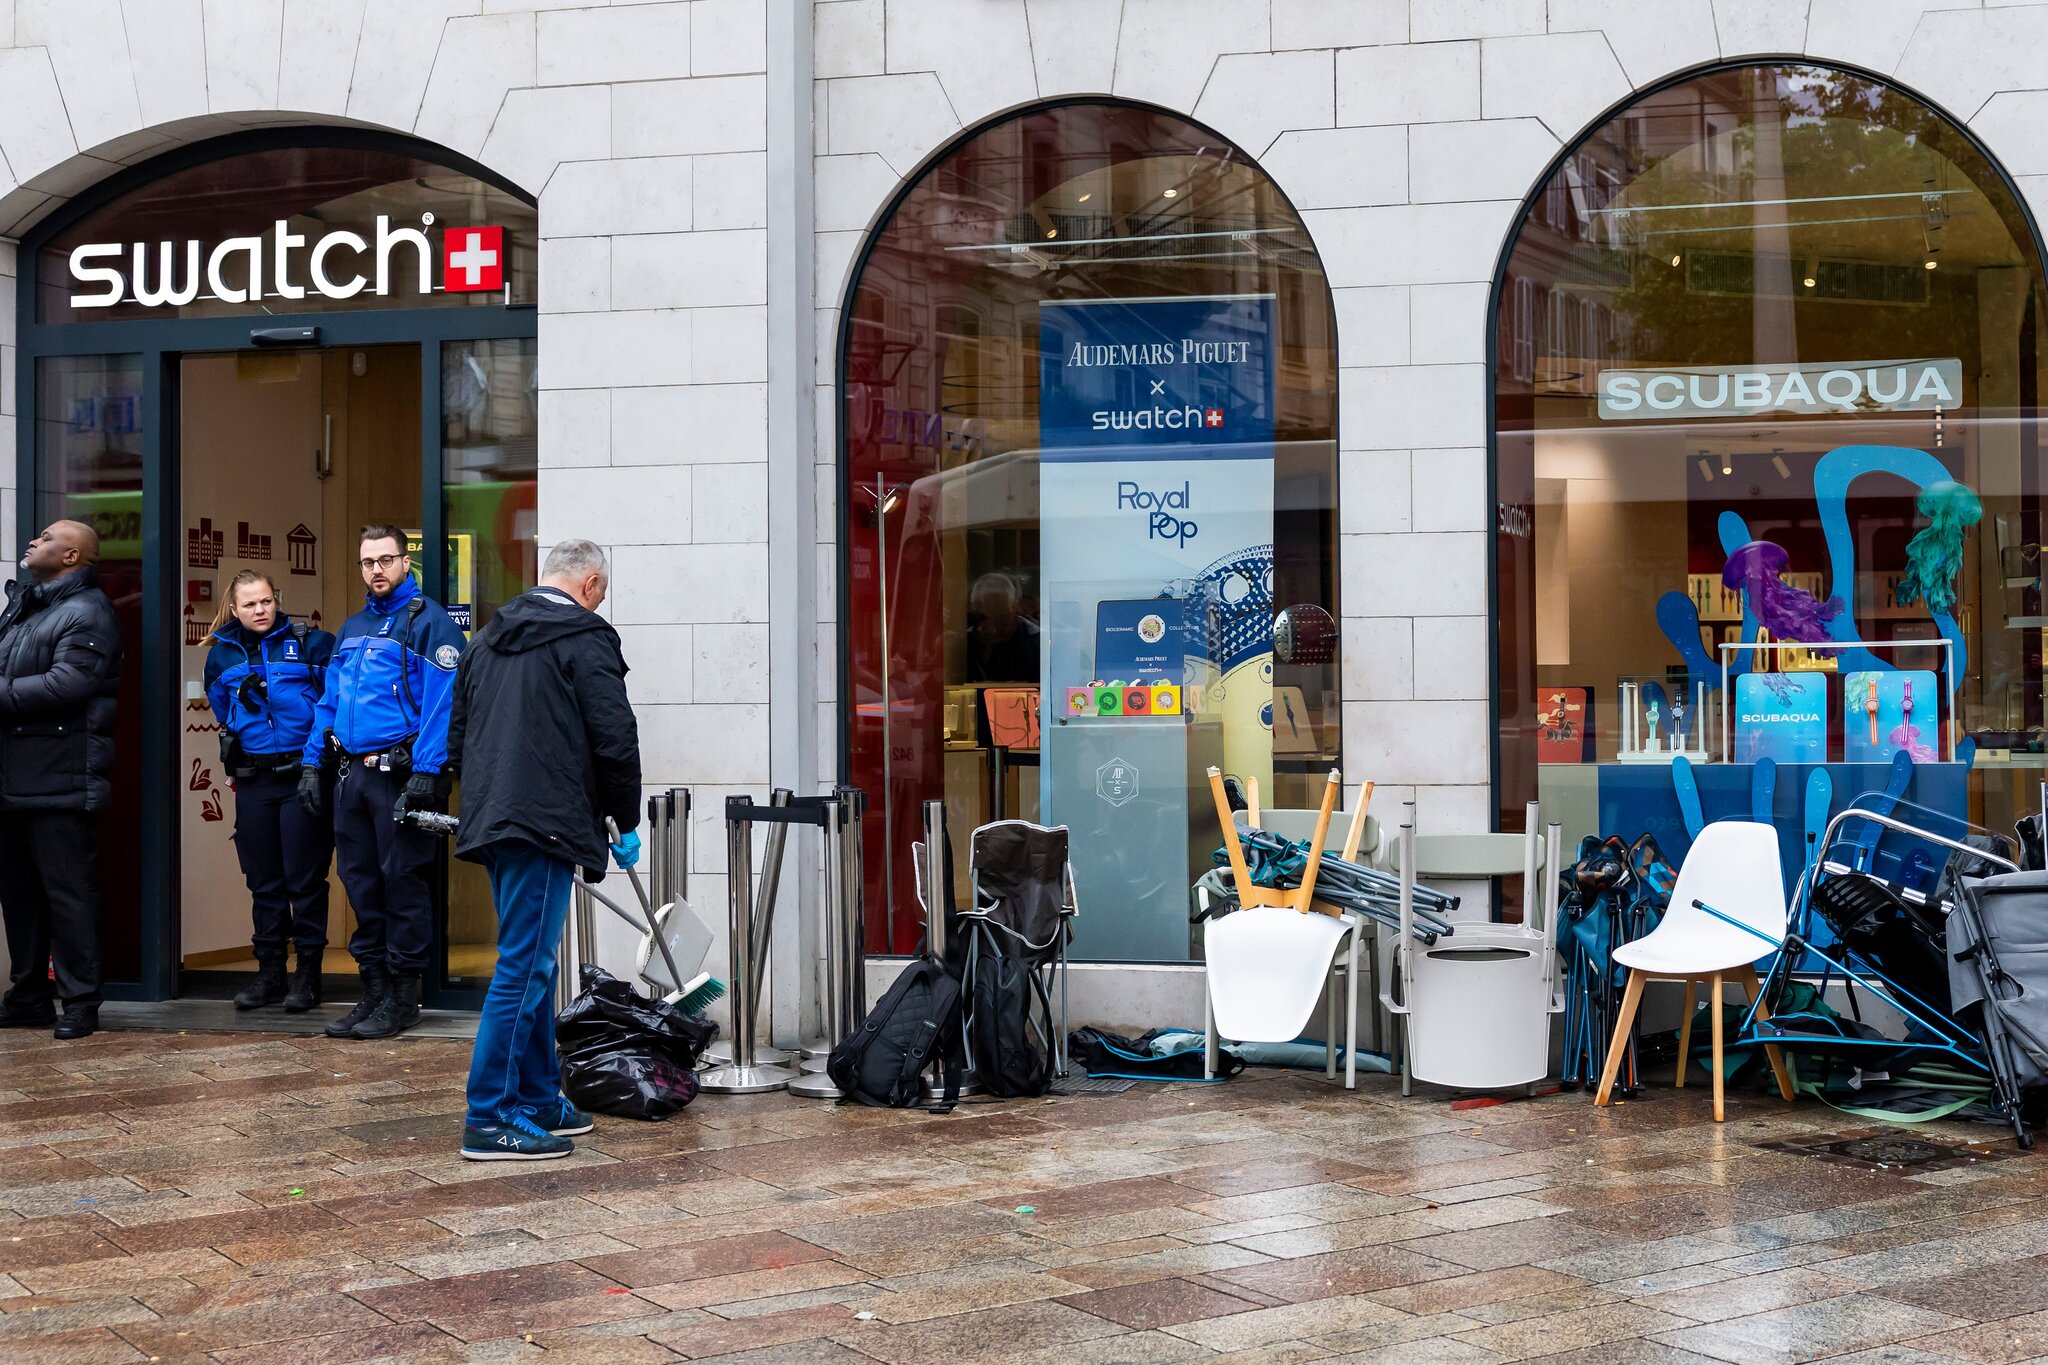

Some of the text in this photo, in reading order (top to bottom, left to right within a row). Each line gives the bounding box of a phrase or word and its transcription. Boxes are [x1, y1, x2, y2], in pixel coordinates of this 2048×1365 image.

[68, 214, 432, 308] swatch
[1067, 338, 1250, 367] AUDEMARS PIGUET
[1604, 367, 1953, 411] SCUBAQUA
[1092, 405, 1203, 430] swatch
[1118, 481, 1189, 518] Royal
[451, 616, 470, 625] AY!
[1742, 713, 1820, 723] SCUBAQUA
